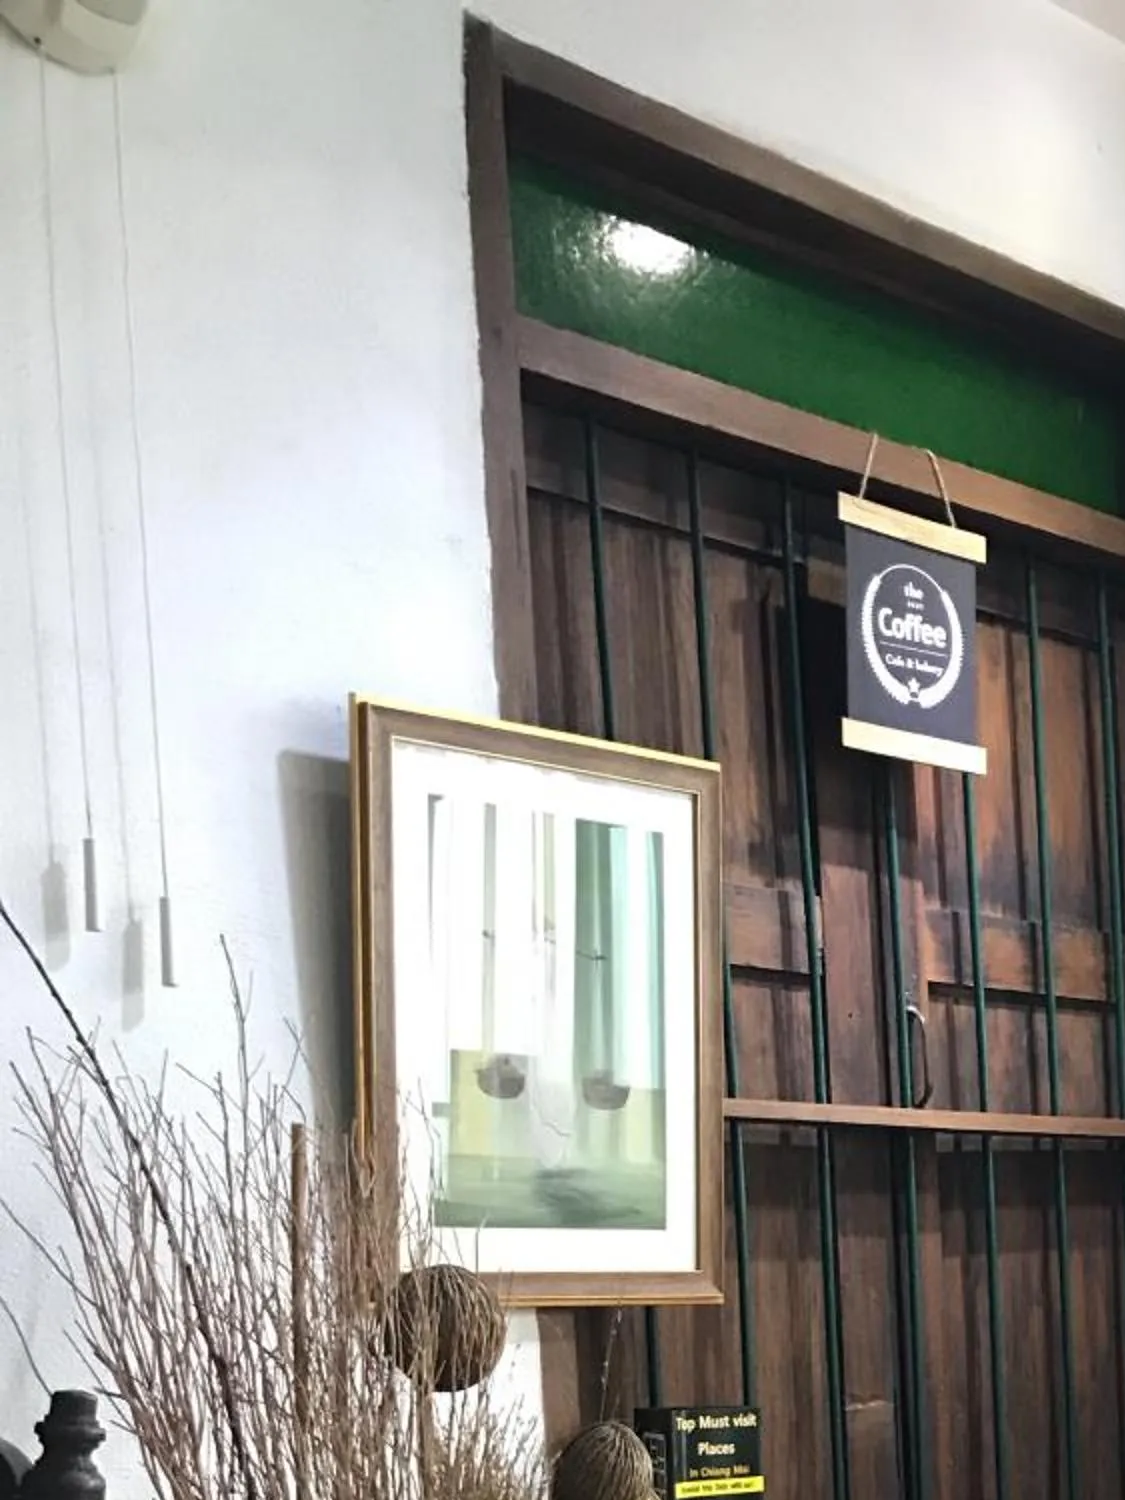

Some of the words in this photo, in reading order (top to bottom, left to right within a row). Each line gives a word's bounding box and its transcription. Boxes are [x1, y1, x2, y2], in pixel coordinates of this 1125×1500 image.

[903, 581, 925, 600] the
[878, 607, 948, 649] Coffee
[676, 1417, 697, 1433] Top
[699, 1415, 730, 1429] Must
[733, 1413, 757, 1427] visit
[697, 1441, 736, 1456] Places
